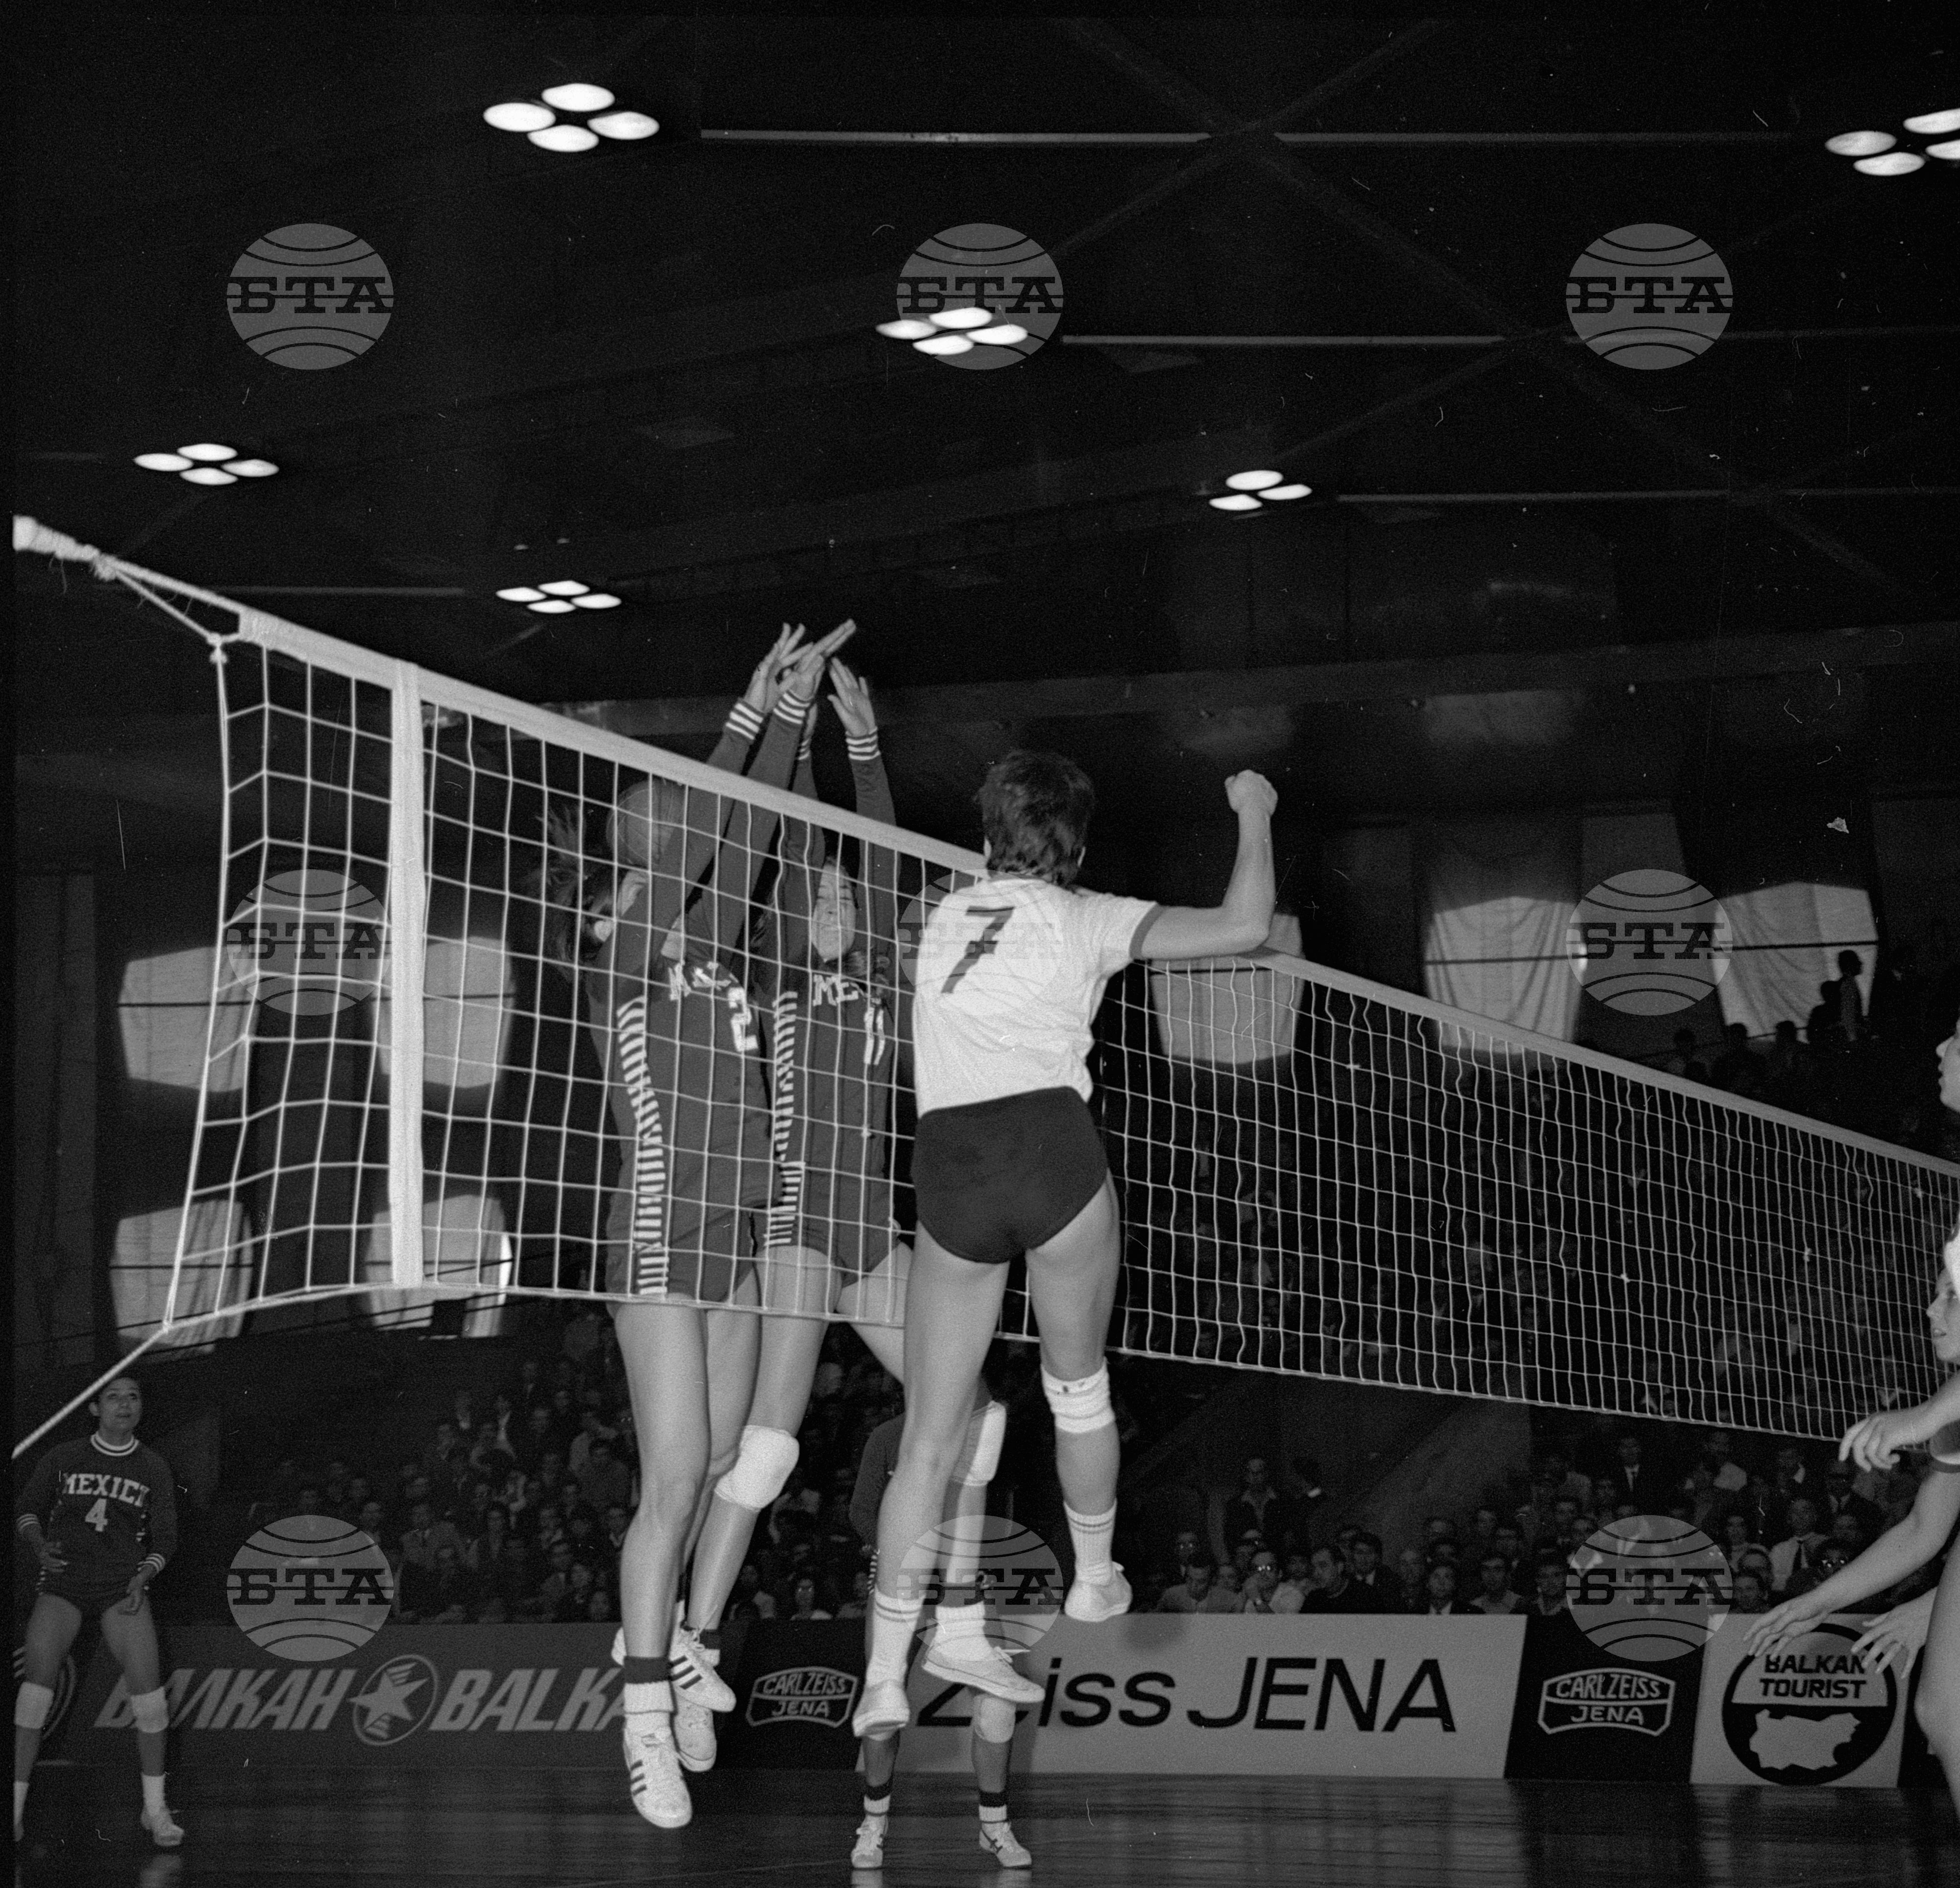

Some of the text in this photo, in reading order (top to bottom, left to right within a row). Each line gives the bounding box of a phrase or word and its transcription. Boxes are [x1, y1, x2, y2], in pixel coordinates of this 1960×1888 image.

[941, 906, 1015, 994] 7
[727, 986, 759, 1053] 2
[85, 1497, 108, 1532] 4
[1765, 1654, 1865, 1673] BALKAN
[916, 1657, 1456, 1733] Ziss JENA
[1760, 1678, 1866, 1699] TOURIST
[771, 1699, 830, 1718] JENA
[1570, 1705, 1645, 1726] JENA
